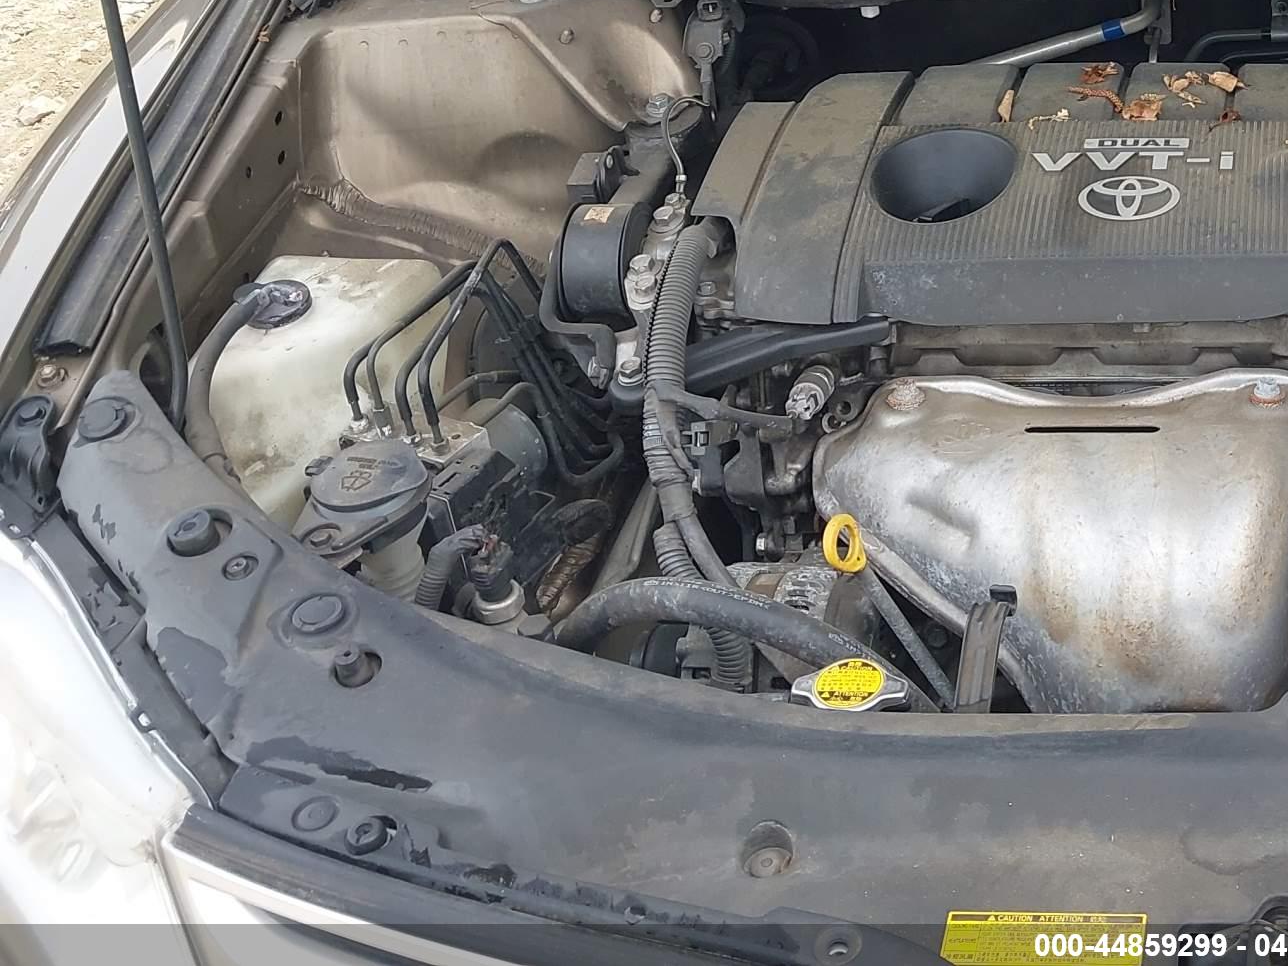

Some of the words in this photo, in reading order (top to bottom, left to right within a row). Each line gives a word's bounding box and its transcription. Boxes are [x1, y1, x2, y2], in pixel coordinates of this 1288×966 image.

[1097, 138, 1182, 147] DUAL
[1031, 151, 1234, 172] VVT-i
[997, 914, 1032, 922] CAUTION
[1039, 915, 1083, 923] ATTENTION
